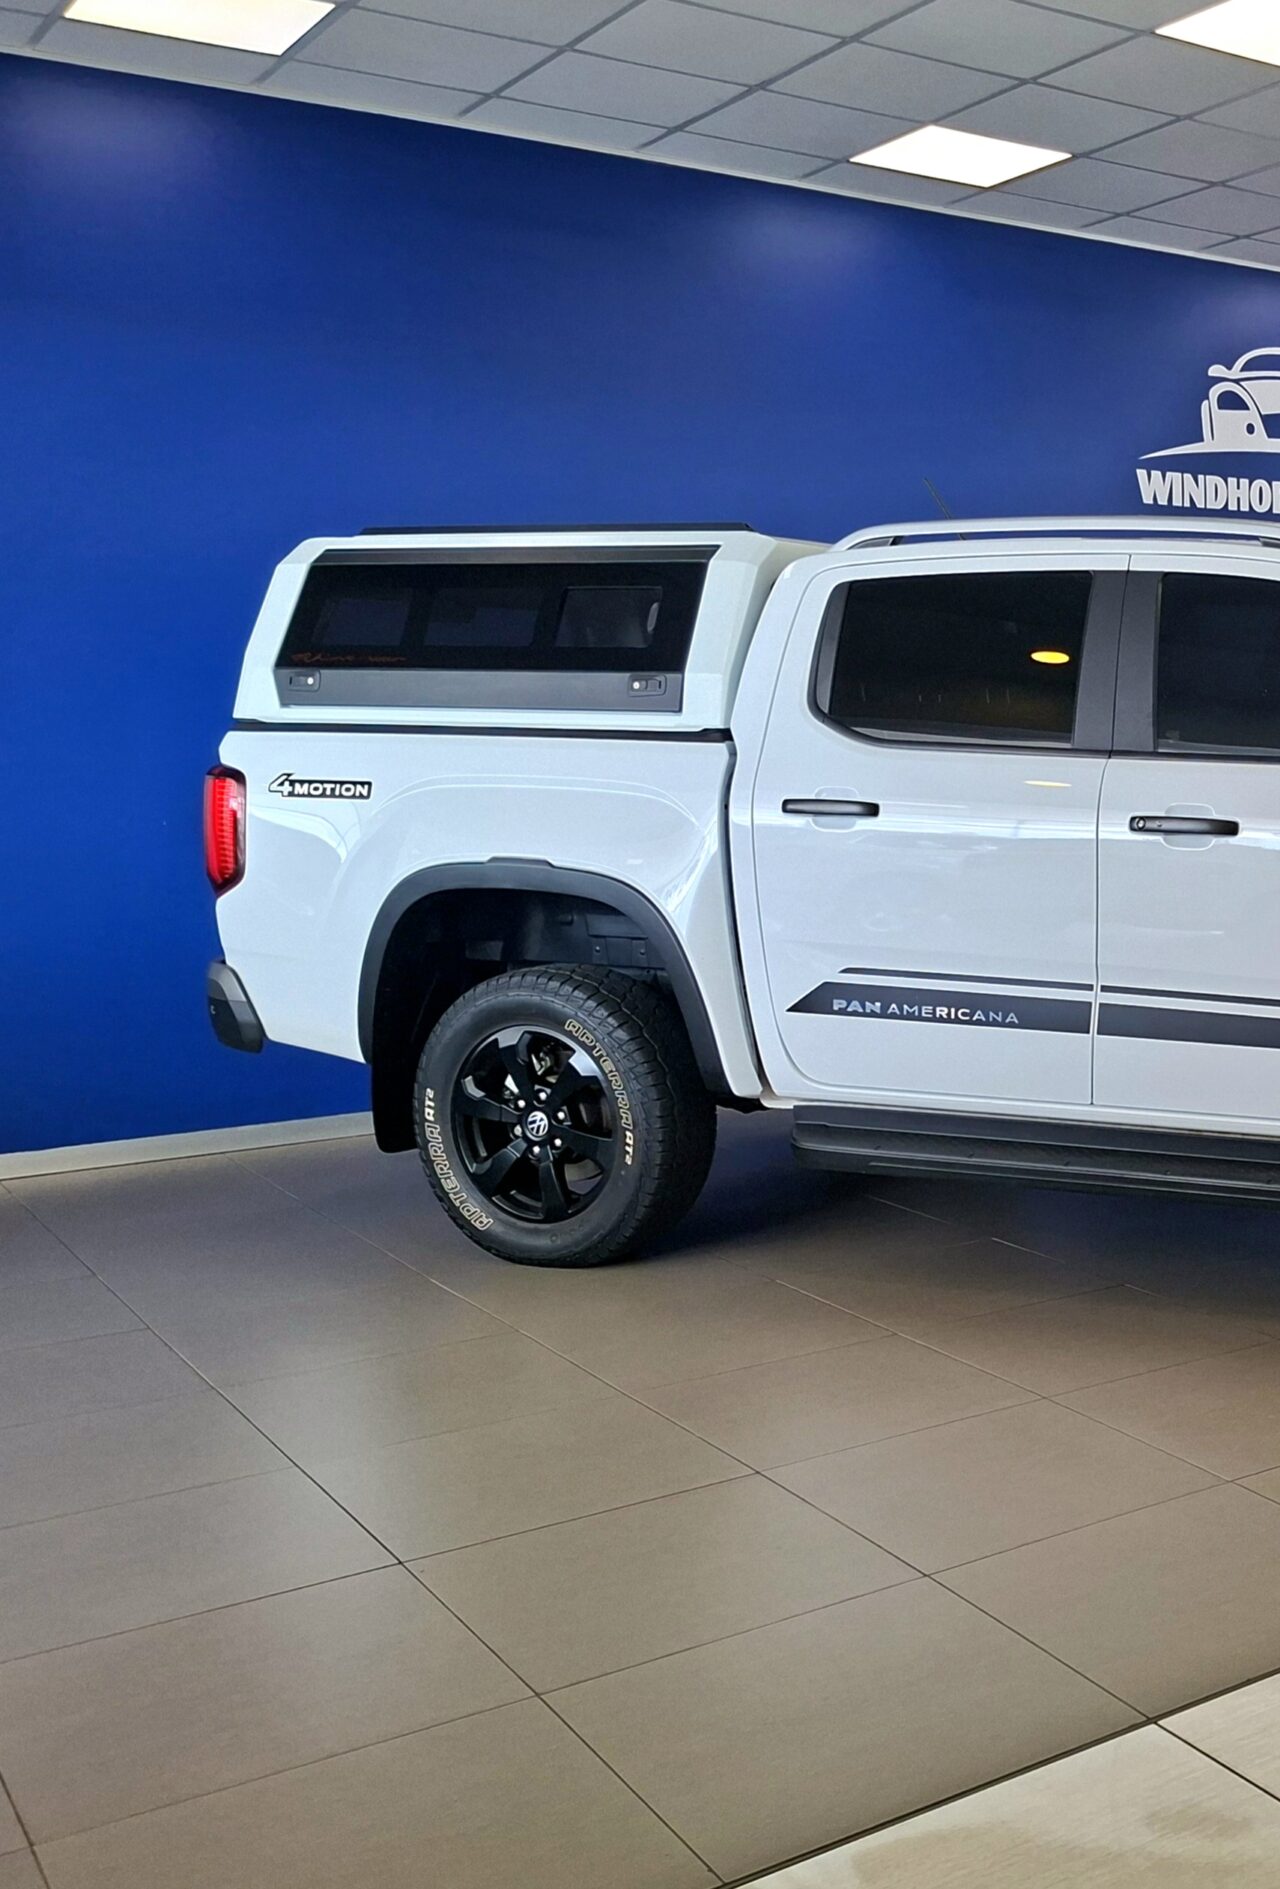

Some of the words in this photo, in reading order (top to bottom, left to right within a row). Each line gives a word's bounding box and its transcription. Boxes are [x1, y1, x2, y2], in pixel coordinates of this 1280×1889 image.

[268, 773, 370, 797] 4MOTION
[832, 999, 881, 1014] PAN
[887, 1003, 1019, 1024] AMERICANA
[564, 1018, 633, 1131] APTERRA
[425, 1120, 494, 1231] APTERRA
